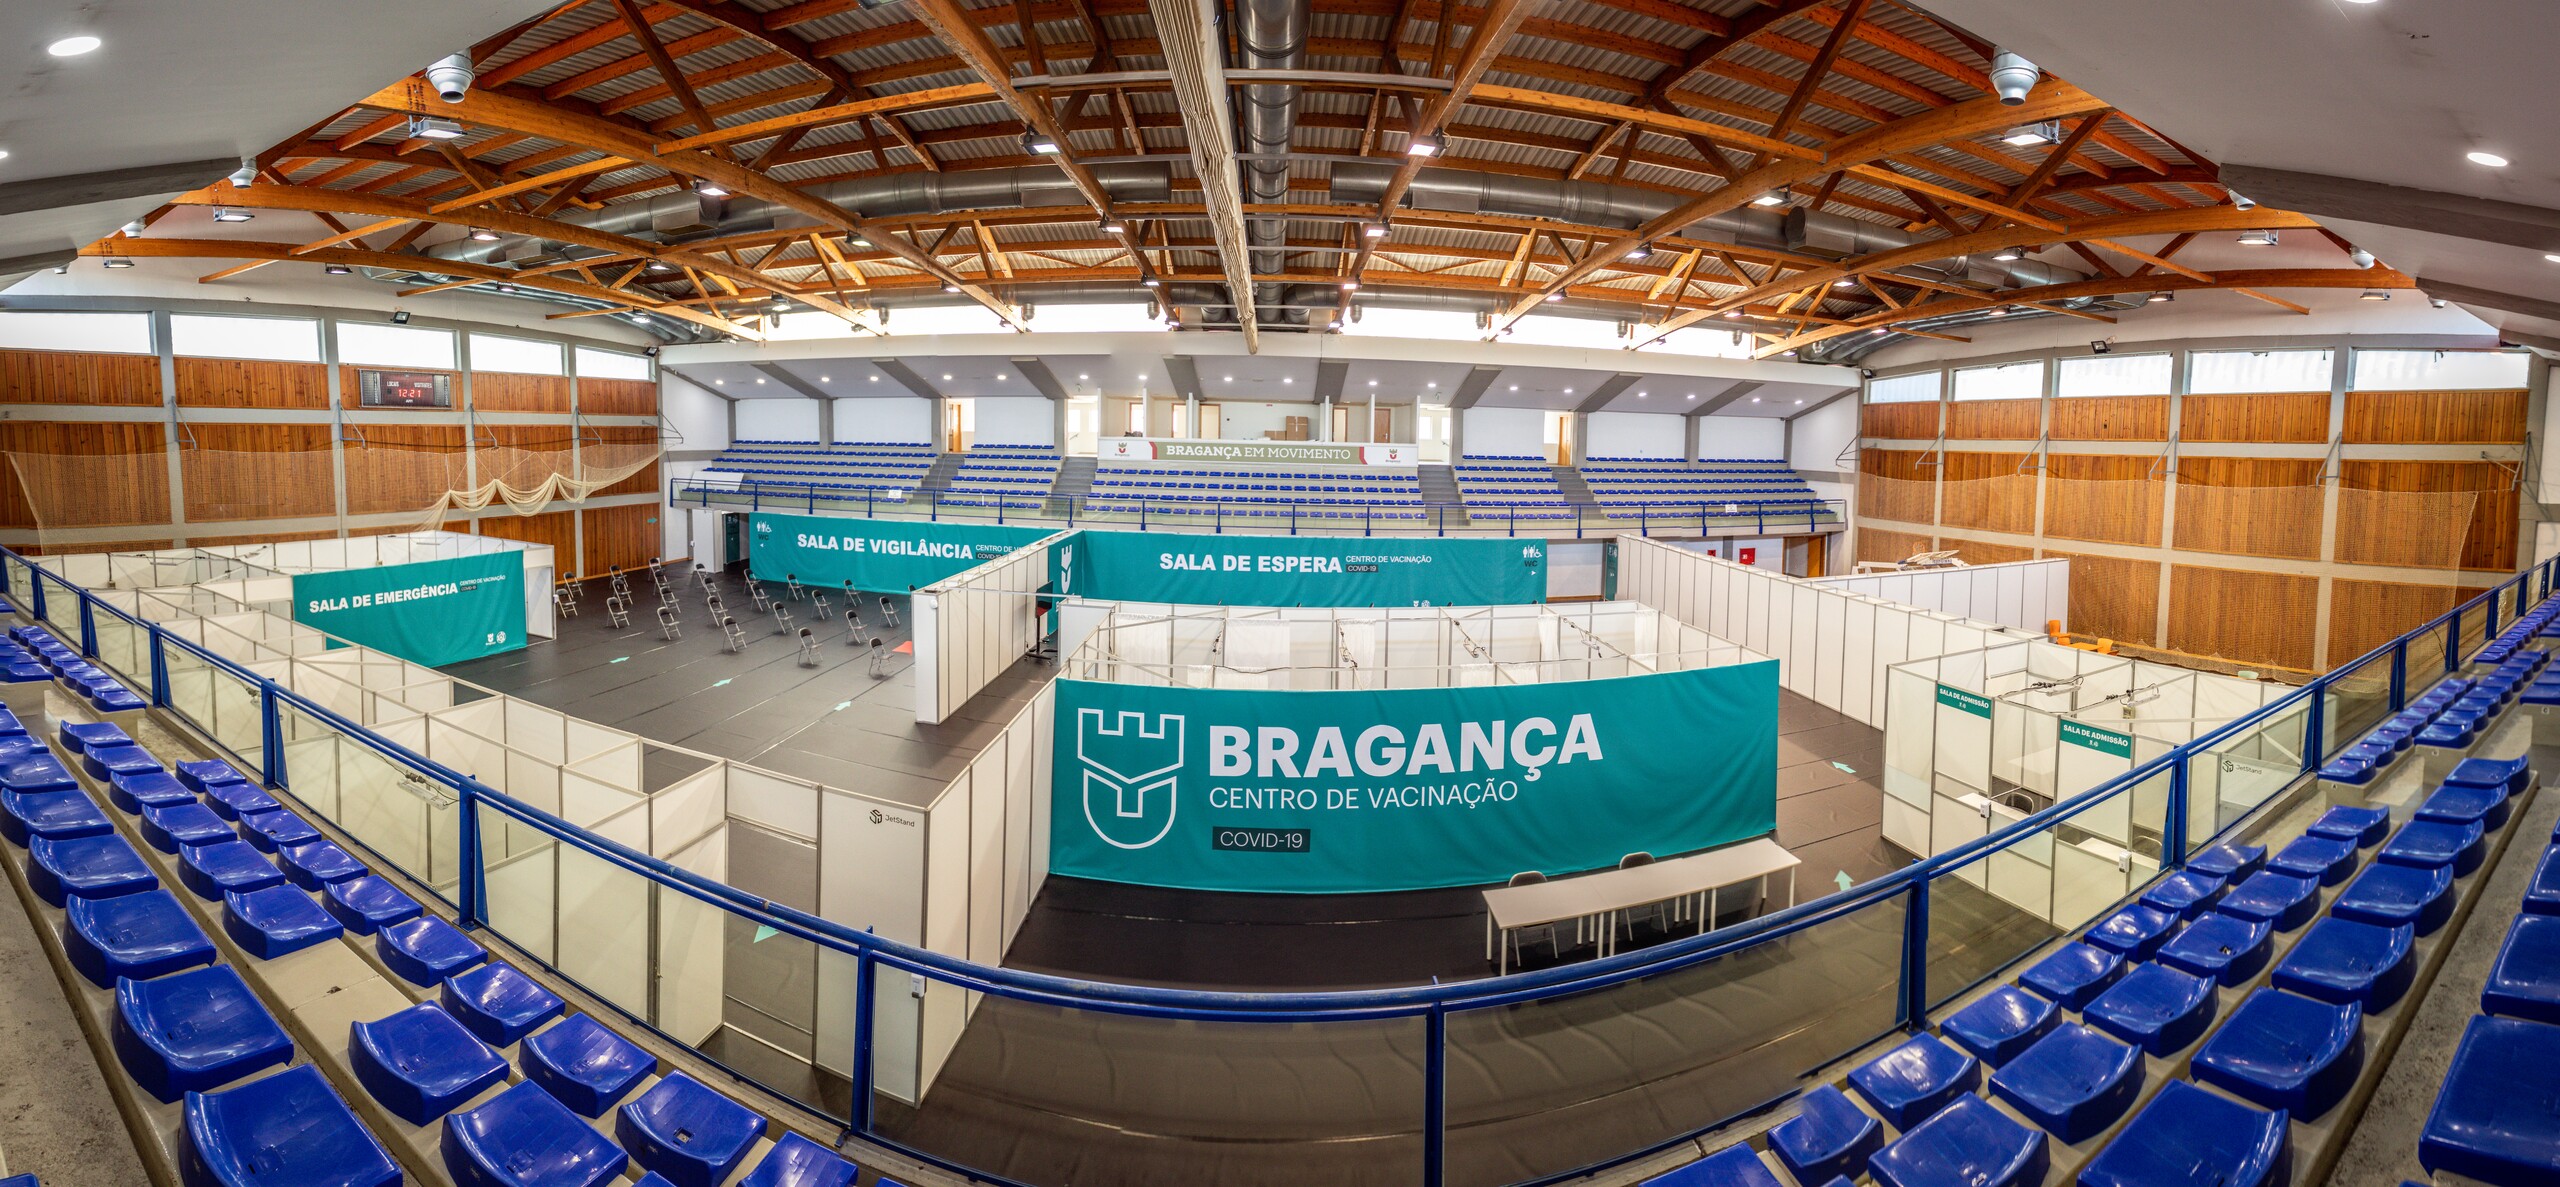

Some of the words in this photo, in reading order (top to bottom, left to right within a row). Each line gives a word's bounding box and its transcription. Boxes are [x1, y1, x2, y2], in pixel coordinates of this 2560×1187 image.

[1166, 445, 1242, 459] BRAGANÇA
[1244, 447, 1265, 458] EM
[1271, 448, 1351, 460] MOVIMENTO
[758, 533, 769, 541] WC
[797, 533, 839, 551] SALA
[843, 537, 865, 553] DE
[869, 538, 973, 560] VIGILÂNCIA
[975, 544, 1002, 553] CENTRO
[1003, 545, 1013, 553] DE
[1159, 553, 1217, 571] SALA
[1223, 554, 1251, 572] DE
[1257, 555, 1343, 573] ESPERA
[1345, 555, 1377, 563] CENTRO
[1378, 555, 1388, 563] DE
[1389, 554, 1432, 564] VACINAÇÃO
[309, 597, 349, 613] SALA
[352, 594, 371, 608] DE
[375, 582, 458, 605] EMERGÊNCIA
[1939, 688, 1953, 697] SALA
[1952, 692, 1960, 700] DE
[1960, 694, 1990, 709] ADMISSÃO
[2063, 724, 2081, 735] SALA
[2081, 729, 2091, 737] DE
[2091, 732, 2129, 747] ADMISSÃO
[1208, 712, 1604, 782] BRAGANÇA
[2235, 764, 2263, 775] JetStand
[1209, 786, 1318, 811] CENTRO
[1326, 788, 1360, 811] DE
[1367, 777, 1519, 811] VACINAÇÃO
[884, 814, 915, 828] JetStand
[1219, 831, 1304, 850] COVID-19
